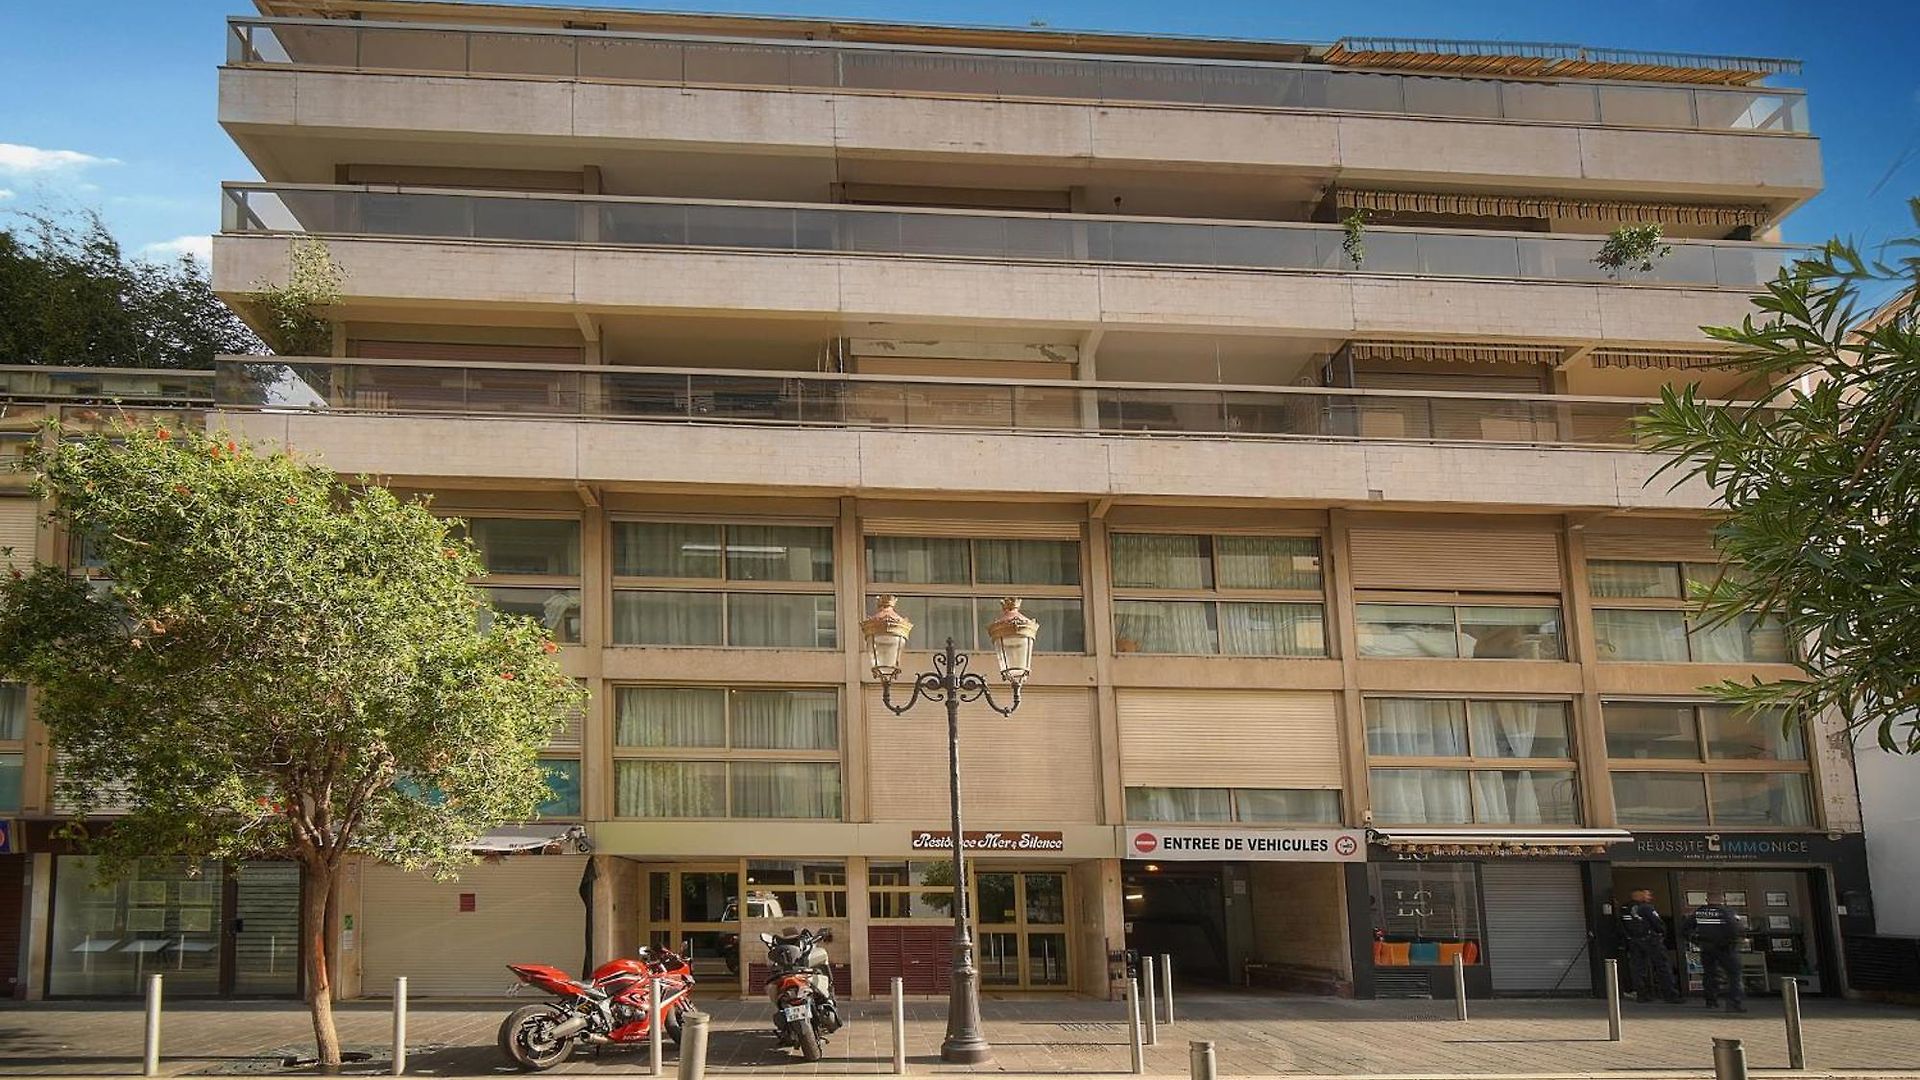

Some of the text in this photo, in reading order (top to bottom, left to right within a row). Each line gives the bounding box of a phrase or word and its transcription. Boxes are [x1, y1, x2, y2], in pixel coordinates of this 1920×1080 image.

[913, 833, 976, 848] Résidce
[978, 833, 1012, 848] Mer
[1019, 833, 1062, 848] Silence
[1163, 837, 1328, 851] ENTREE DE VEHICULES
[1637, 837, 1808, 853] RÉUSSITE IMMONICE
